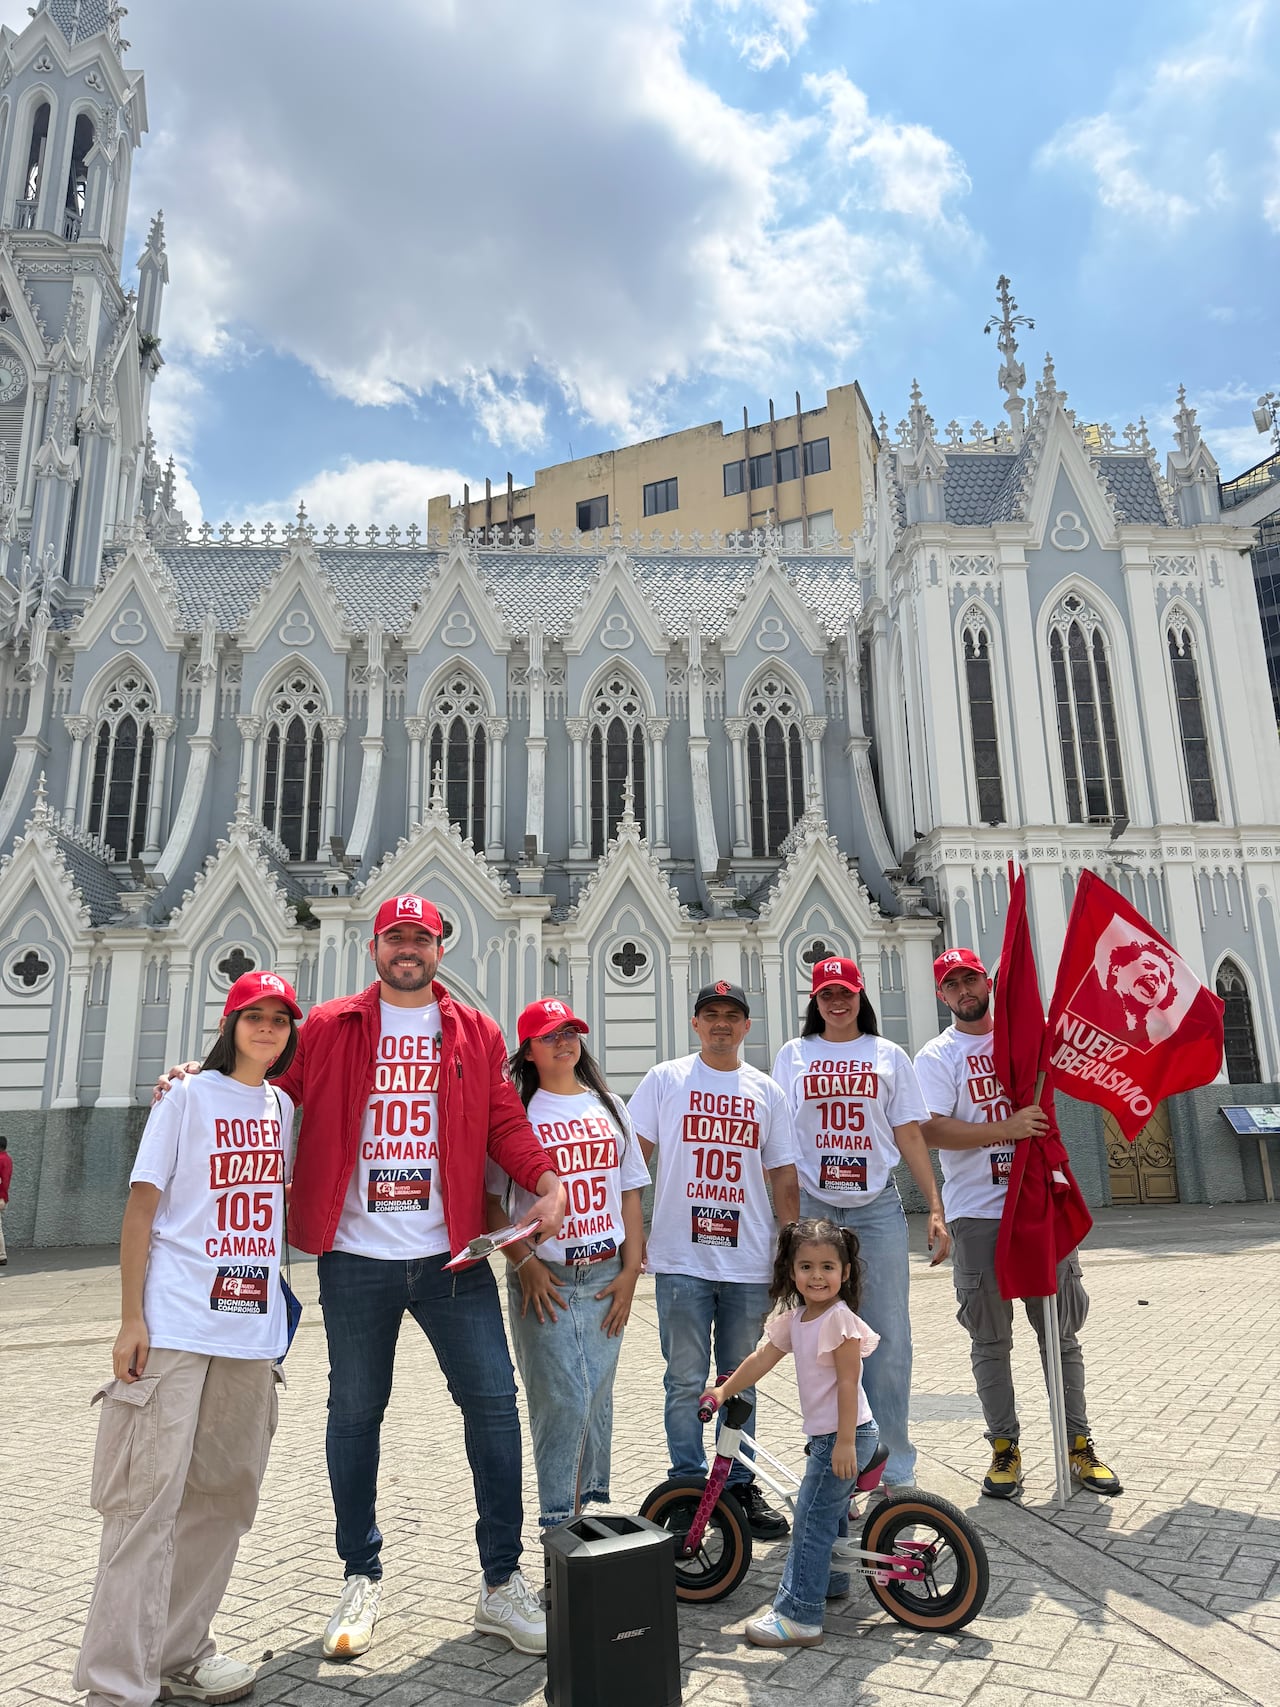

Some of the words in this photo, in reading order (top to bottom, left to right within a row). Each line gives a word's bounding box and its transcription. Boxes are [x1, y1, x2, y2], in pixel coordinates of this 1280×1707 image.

[377, 1035, 441, 1060] OGE
[1055, 1012, 1129, 1062] NUEVO
[371, 1065, 440, 1091] OAIZ
[809, 1060, 873, 1073] ROGER
[806, 1075, 874, 1097] LOAIZA
[971, 1077, 1004, 1100] LOA
[1050, 1043, 1152, 1116] IBERALISMO
[690, 1090, 756, 1120] ROGER
[816, 1101, 865, 1132] 105
[982, 1101, 1013, 1123] 10
[369, 1100, 431, 1136] 105
[215, 1118, 281, 1148] ROGER
[537, 1118, 614, 1144] ROGER
[686, 1117, 754, 1147] LOAIZA
[816, 1131, 873, 1150] CÁMARA
[362, 1138, 440, 1160] CÁMARA
[545, 1142, 615, 1174] OAIZA
[996, 1153, 1014, 1162] MI
[214, 1153, 284, 1186] LOAIZA
[692, 1147, 742, 1183] 105
[825, 1156, 861, 1166] MIRA
[376, 1169, 423, 1181] MIRA
[686, 1180, 745, 1204] CÁMARA
[216, 1192, 273, 1231] 105
[375, 1200, 412, 1208] DIGNIDAD
[375, 1204, 421, 1212] COMPROMISO
[697, 1207, 734, 1220] MIRA
[205, 1233, 276, 1258] CÁMARA
[572, 1241, 611, 1258] MIRA
[224, 1265, 265, 1279] MIRA
[218, 1299, 254, 1307] DIGNIDAD
[218, 1305, 260, 1314] COMPROMISO
[613, 1627, 648, 1640] BOSE
